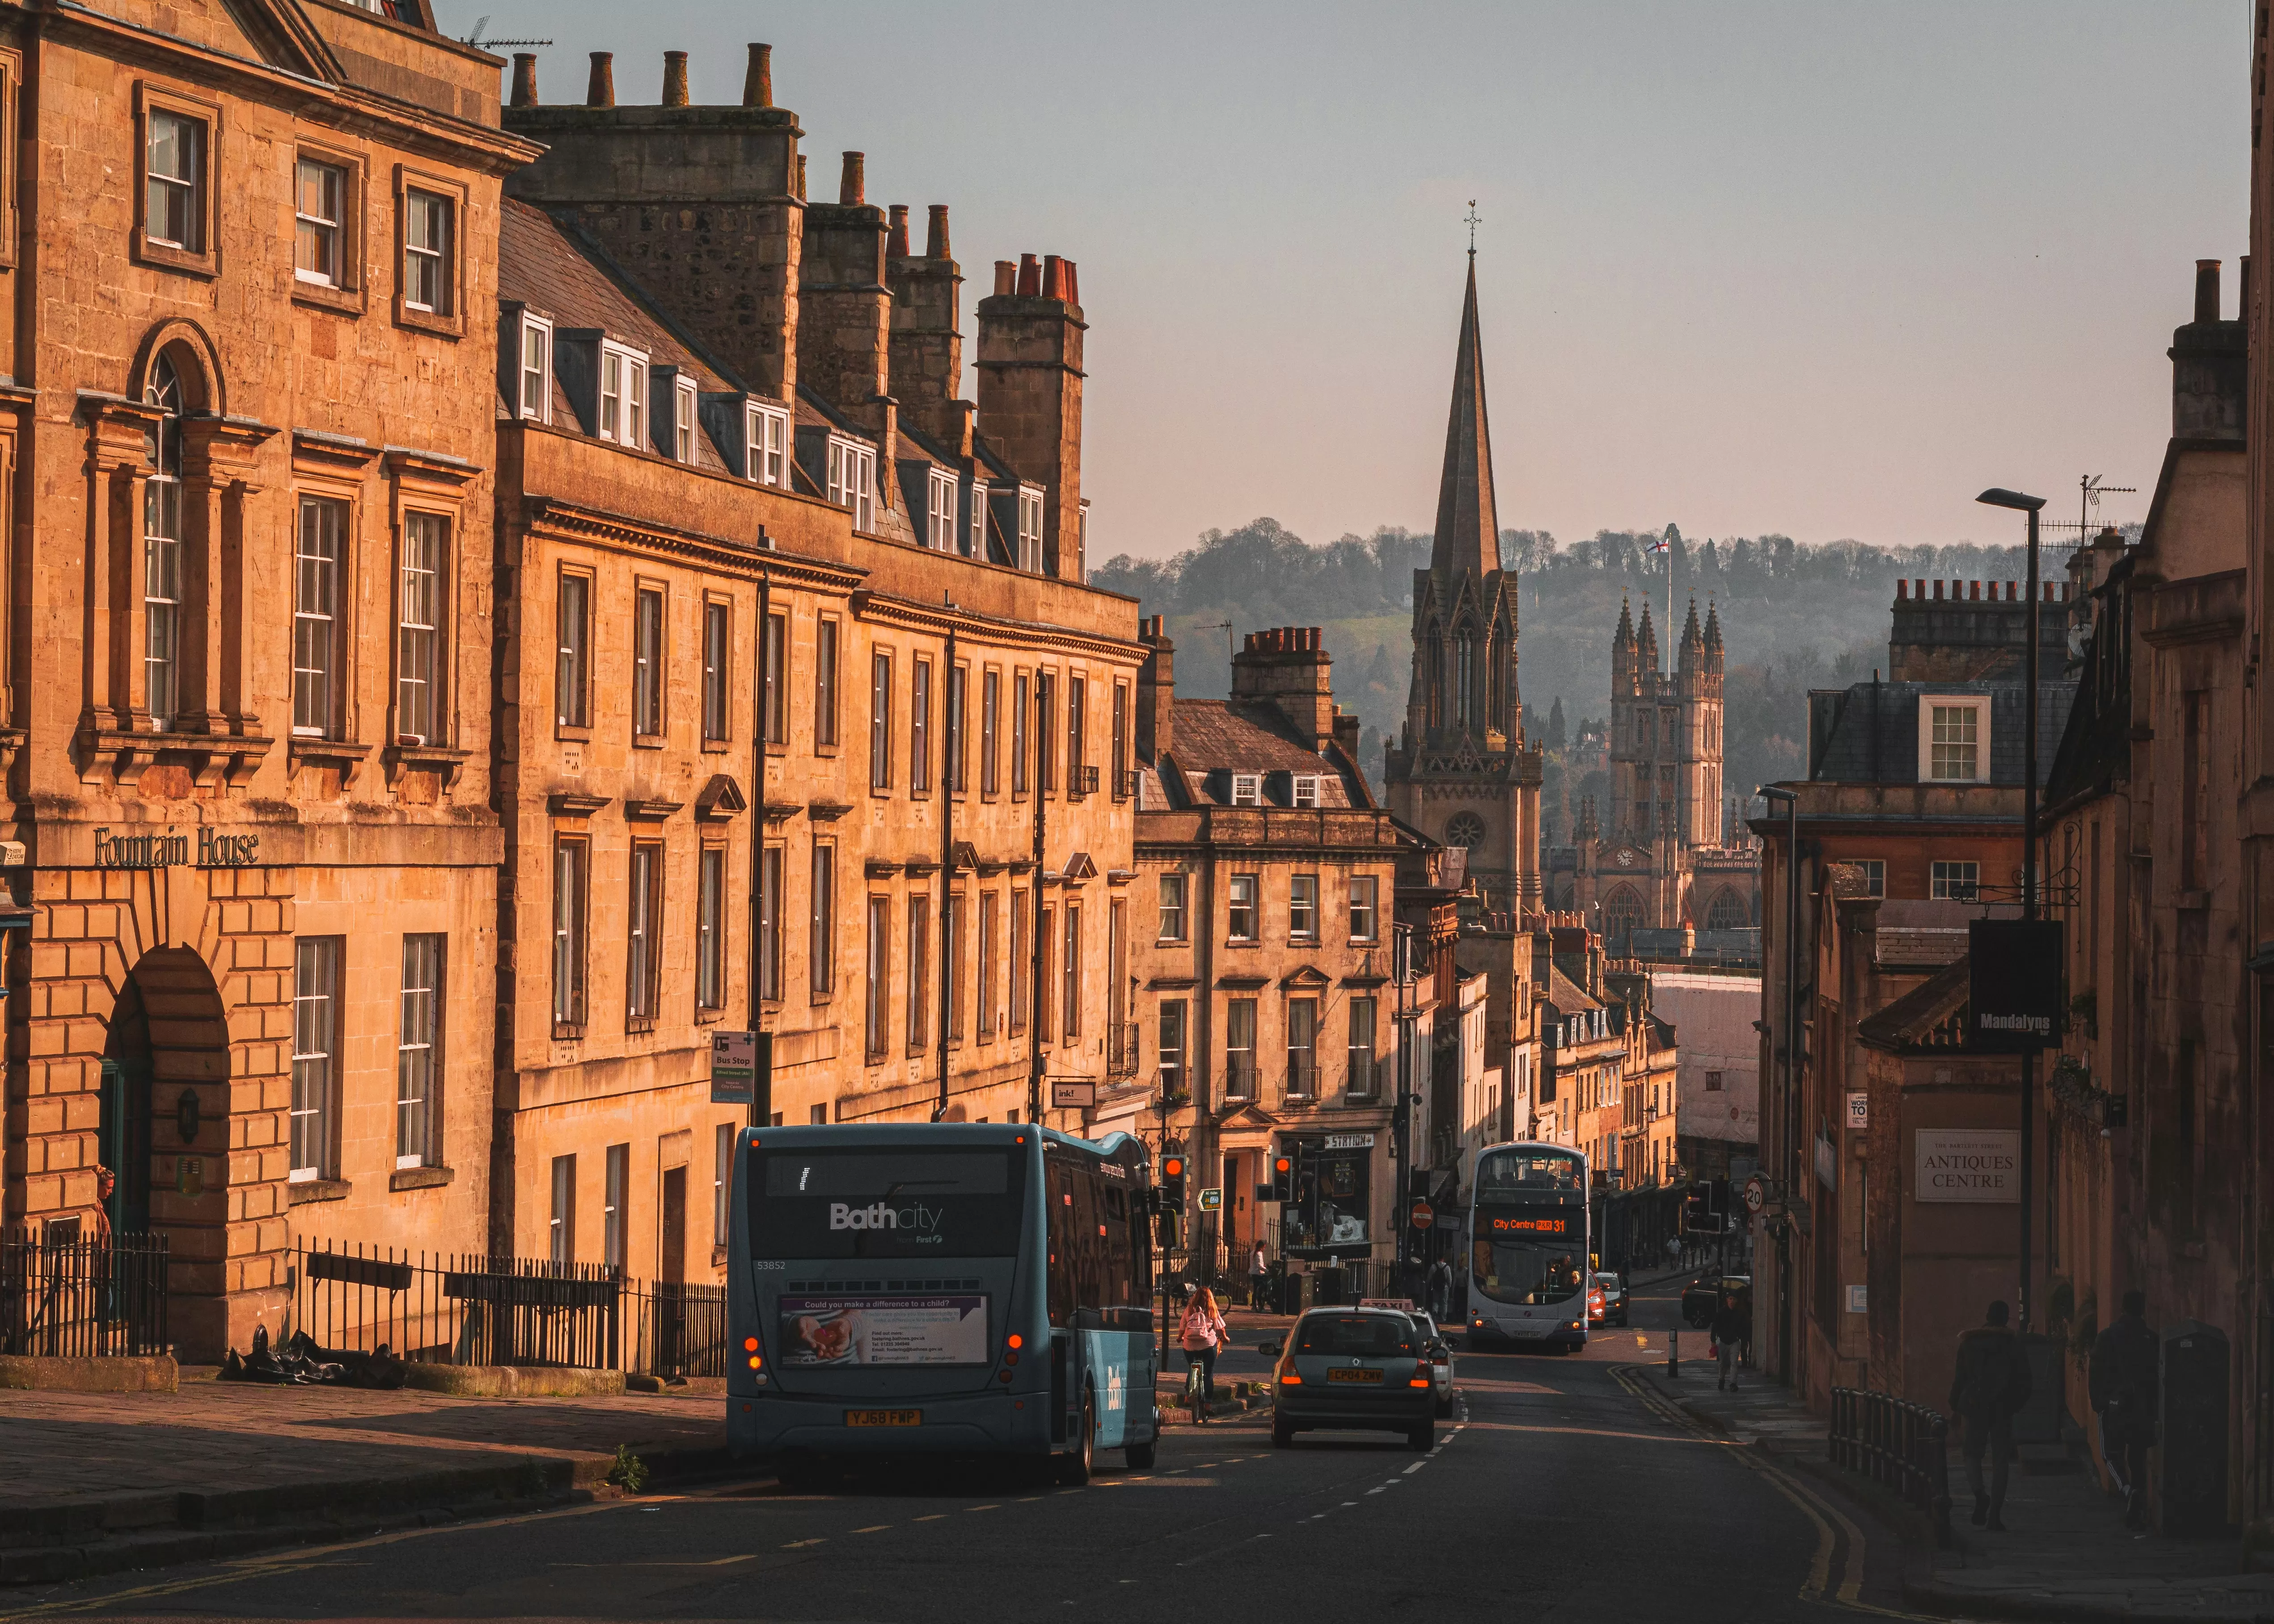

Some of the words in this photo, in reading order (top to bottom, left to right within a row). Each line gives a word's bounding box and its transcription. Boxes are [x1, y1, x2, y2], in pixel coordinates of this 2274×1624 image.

[94, 825, 189, 866] Fountain
[197, 826, 259, 865] House
[1981, 1013, 2050, 1031] Mandalyns
[732, 1057, 750, 1066] Stop
[1851, 1106, 1866, 1116] TO
[1332, 1135, 1366, 1147] STATION
[1924, 1155, 2013, 1172] ANTIQUES
[1932, 1174, 2004, 1188] CENTRE
[1747, 1188, 1761, 1205] 20
[1494, 1219, 1509, 1230] City
[1510, 1219, 1535, 1229] Centre
[1554, 1219, 1564, 1232] 31
[916, 1236, 932, 1244] First
[757, 1261, 786, 1270] 53852
[1372, 1302, 1403, 1310] TAXI
[1335, 1370, 1360, 1380] CP04
[889, 1411, 915, 1425] FWP
